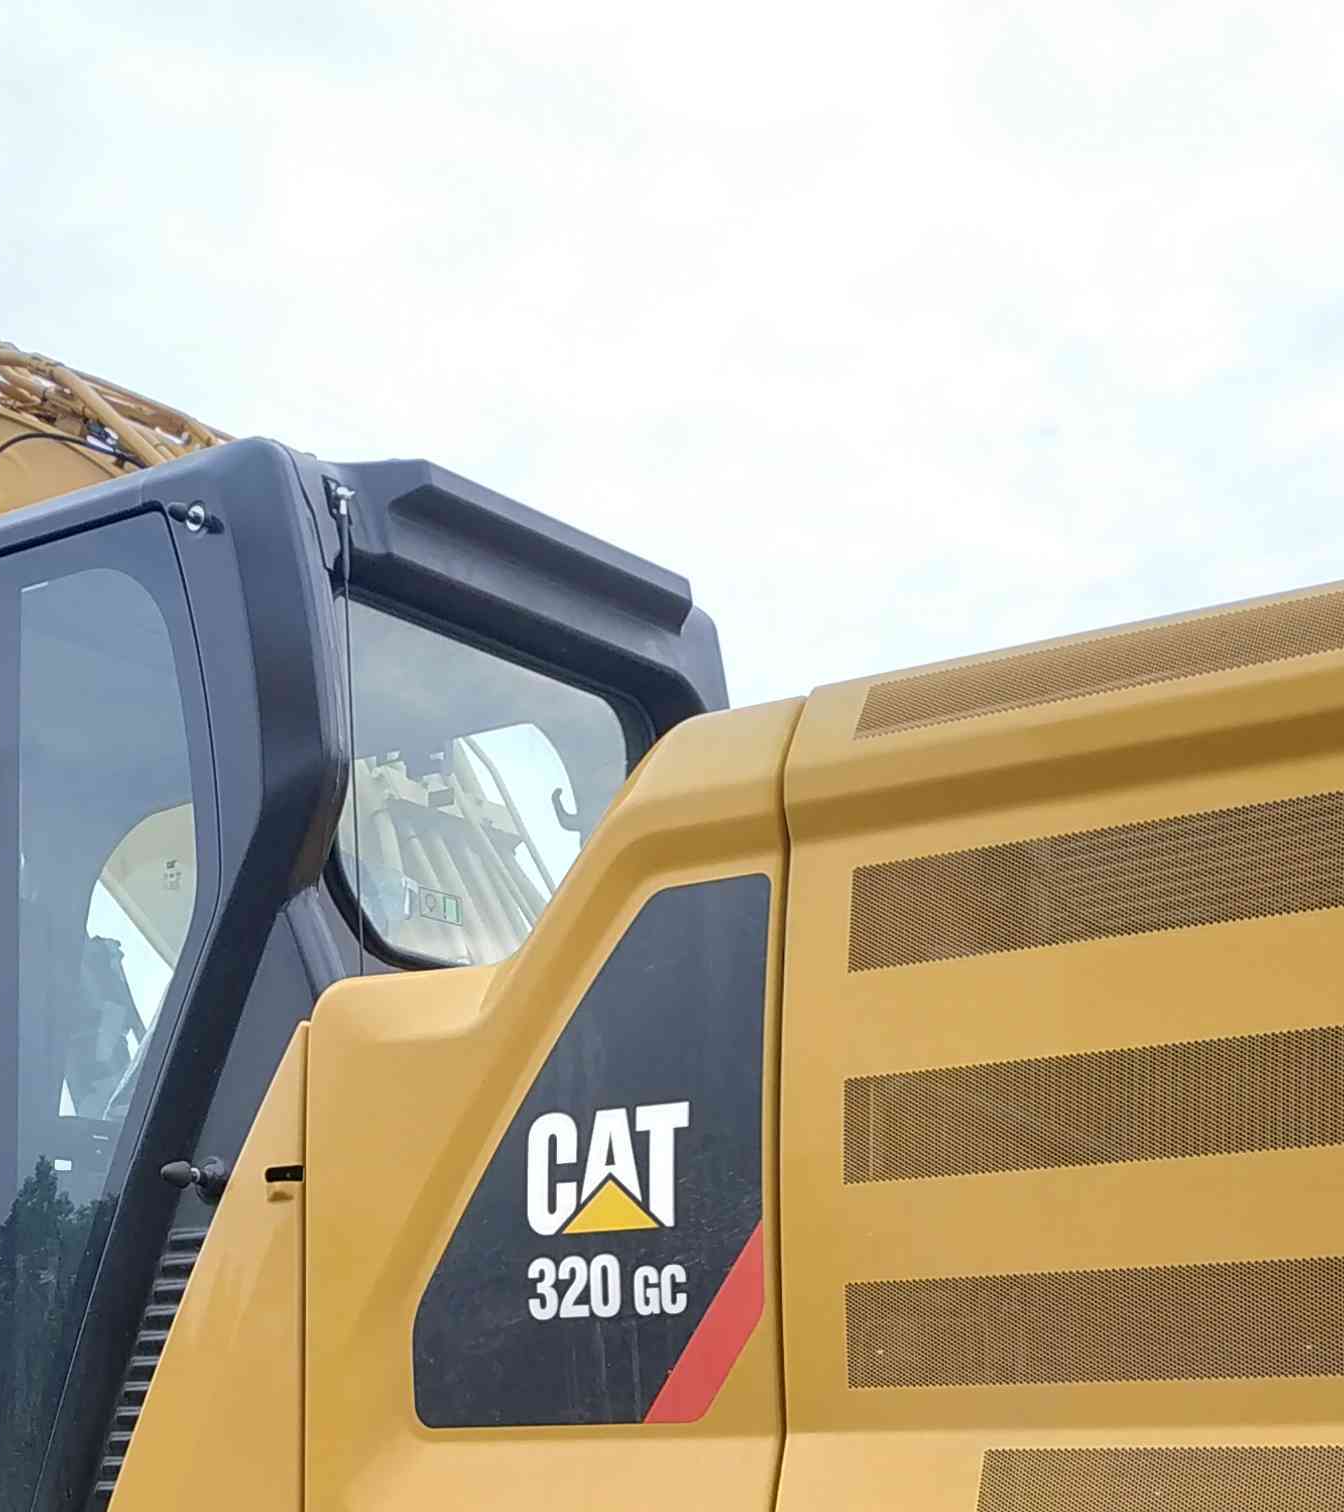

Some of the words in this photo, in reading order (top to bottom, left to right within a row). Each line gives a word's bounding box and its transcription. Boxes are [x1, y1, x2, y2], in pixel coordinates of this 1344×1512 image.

[526, 1100, 691, 1237] CAT
[527, 1252, 622, 1321] 320
[632, 1264, 688, 1317] GC
